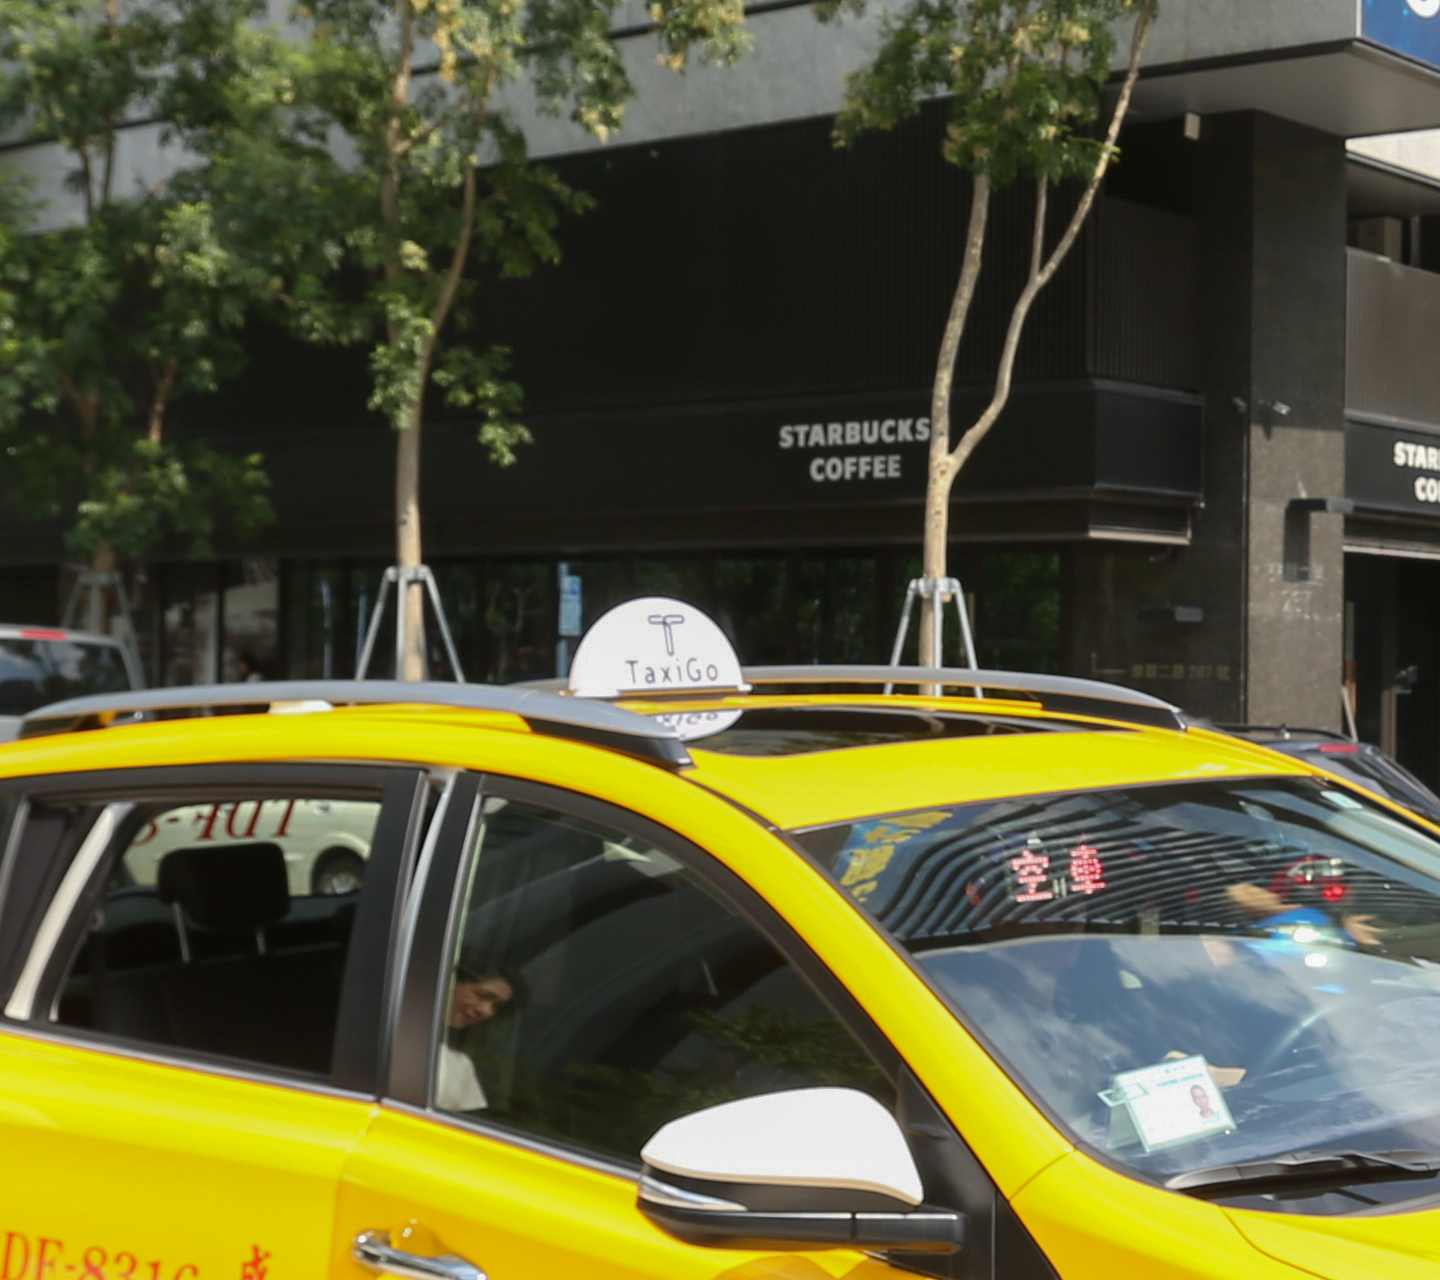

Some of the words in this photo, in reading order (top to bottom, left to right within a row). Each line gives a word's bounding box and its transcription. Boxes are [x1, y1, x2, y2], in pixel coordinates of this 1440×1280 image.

[778, 417, 931, 449] STARBUCKS
[809, 455, 902, 483] COFFEE
[624, 657, 720, 685] TaxiGo
[1010, 843, 1108, 904] 空車
